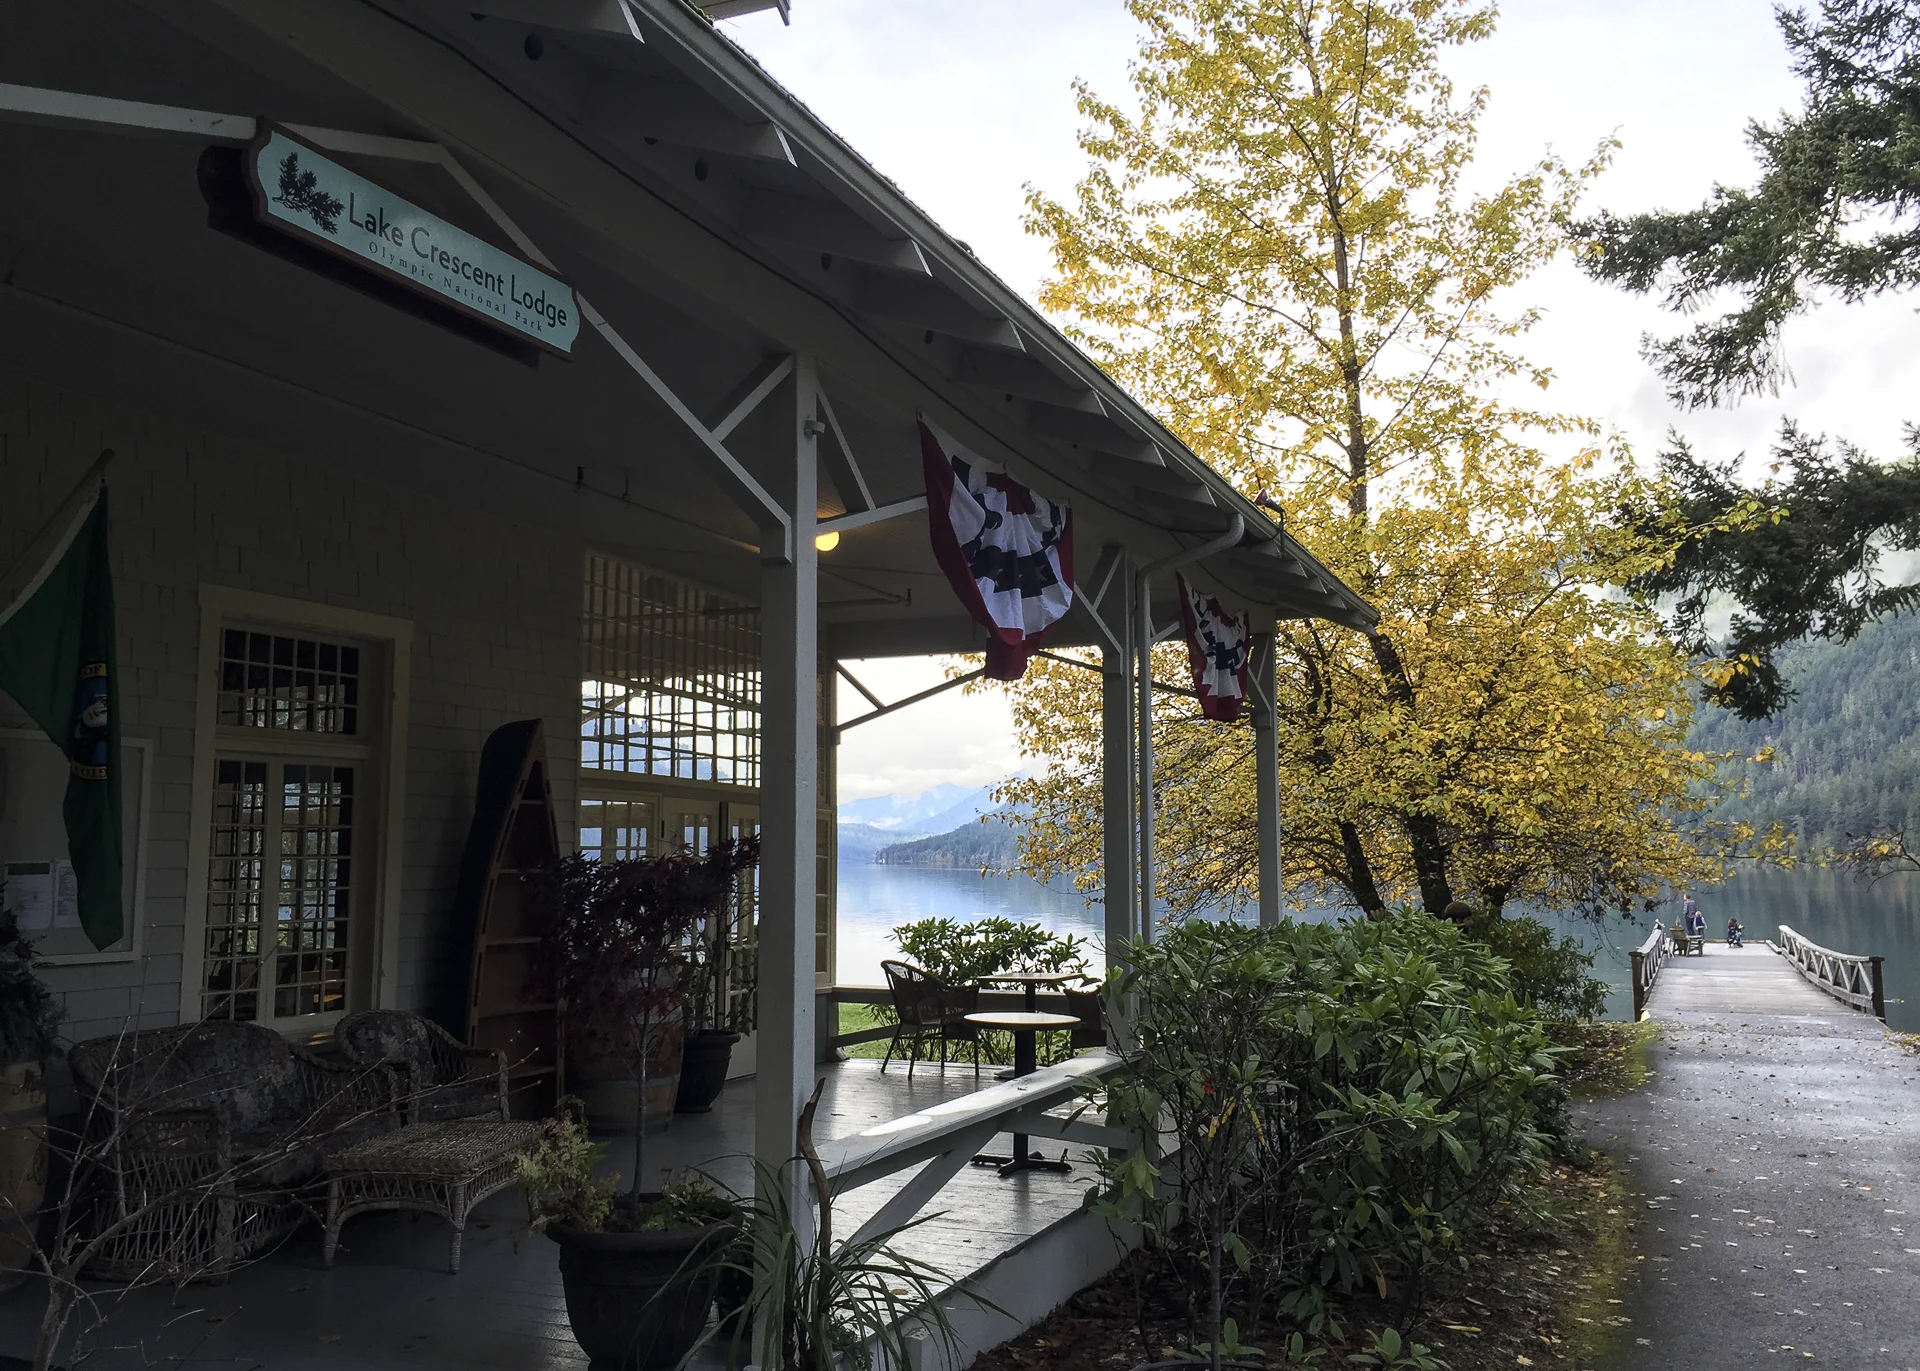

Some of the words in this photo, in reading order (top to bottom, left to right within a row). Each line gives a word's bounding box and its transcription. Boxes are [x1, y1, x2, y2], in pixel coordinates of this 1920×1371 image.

[349, 192, 403, 246] Lake
[411, 226, 504, 296] Crescent
[511, 274, 567, 328] Lodge
[369, 241, 434, 281] Olympic
[443, 276, 506, 315] National
[515, 310, 543, 332] Park
